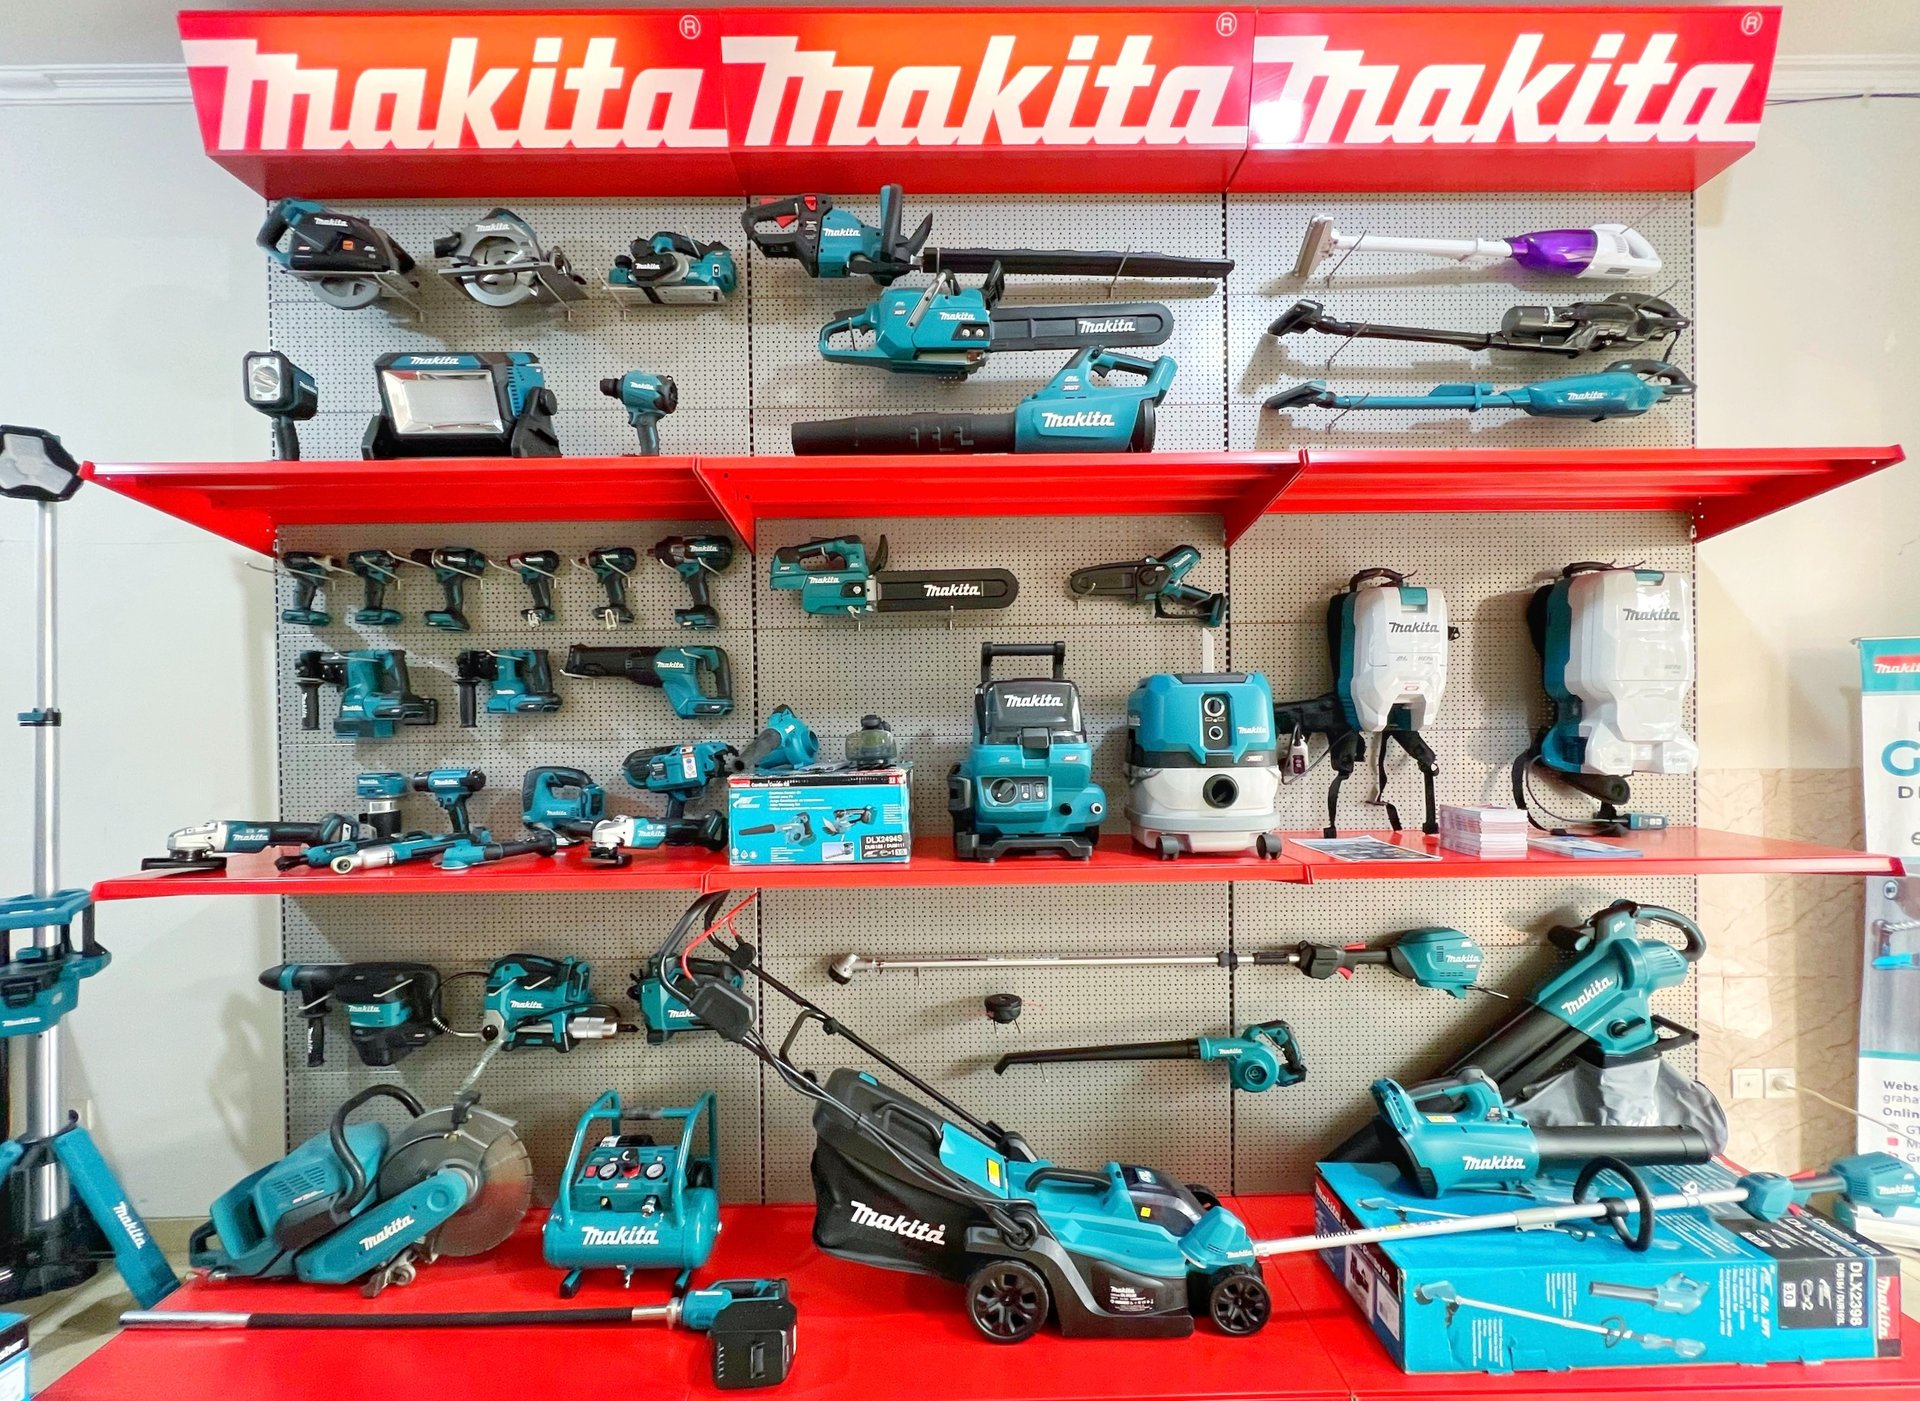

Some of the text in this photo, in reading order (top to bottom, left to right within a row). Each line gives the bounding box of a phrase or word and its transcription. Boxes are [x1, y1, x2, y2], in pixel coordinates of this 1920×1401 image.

[181, 37, 727, 150] Makita
[721, 36, 1248, 146] Makita
[1252, 33, 1761, 144] Makita
[1078, 320, 1136, 333] Makita
[410, 356, 460, 365] Makita
[1041, 411, 1115, 428] Makita
[924, 584, 981, 597] Makita
[1389, 622, 1440, 633] Makita
[1622, 608, 1680, 622] Makita
[1003, 694, 1065, 708] Makita
[1561, 977, 1613, 1016] Makita
[1462, 1155, 1526, 1171] Makita
[112, 1201, 145, 1251] Makita
[359, 1214, 415, 1251] Makita
[582, 1225, 660, 1246] Makita
[850, 1201, 945, 1246] Makita
[1849, 1262, 1864, 1326] DLX2398
[1877, 1276, 1891, 1340] Makita
